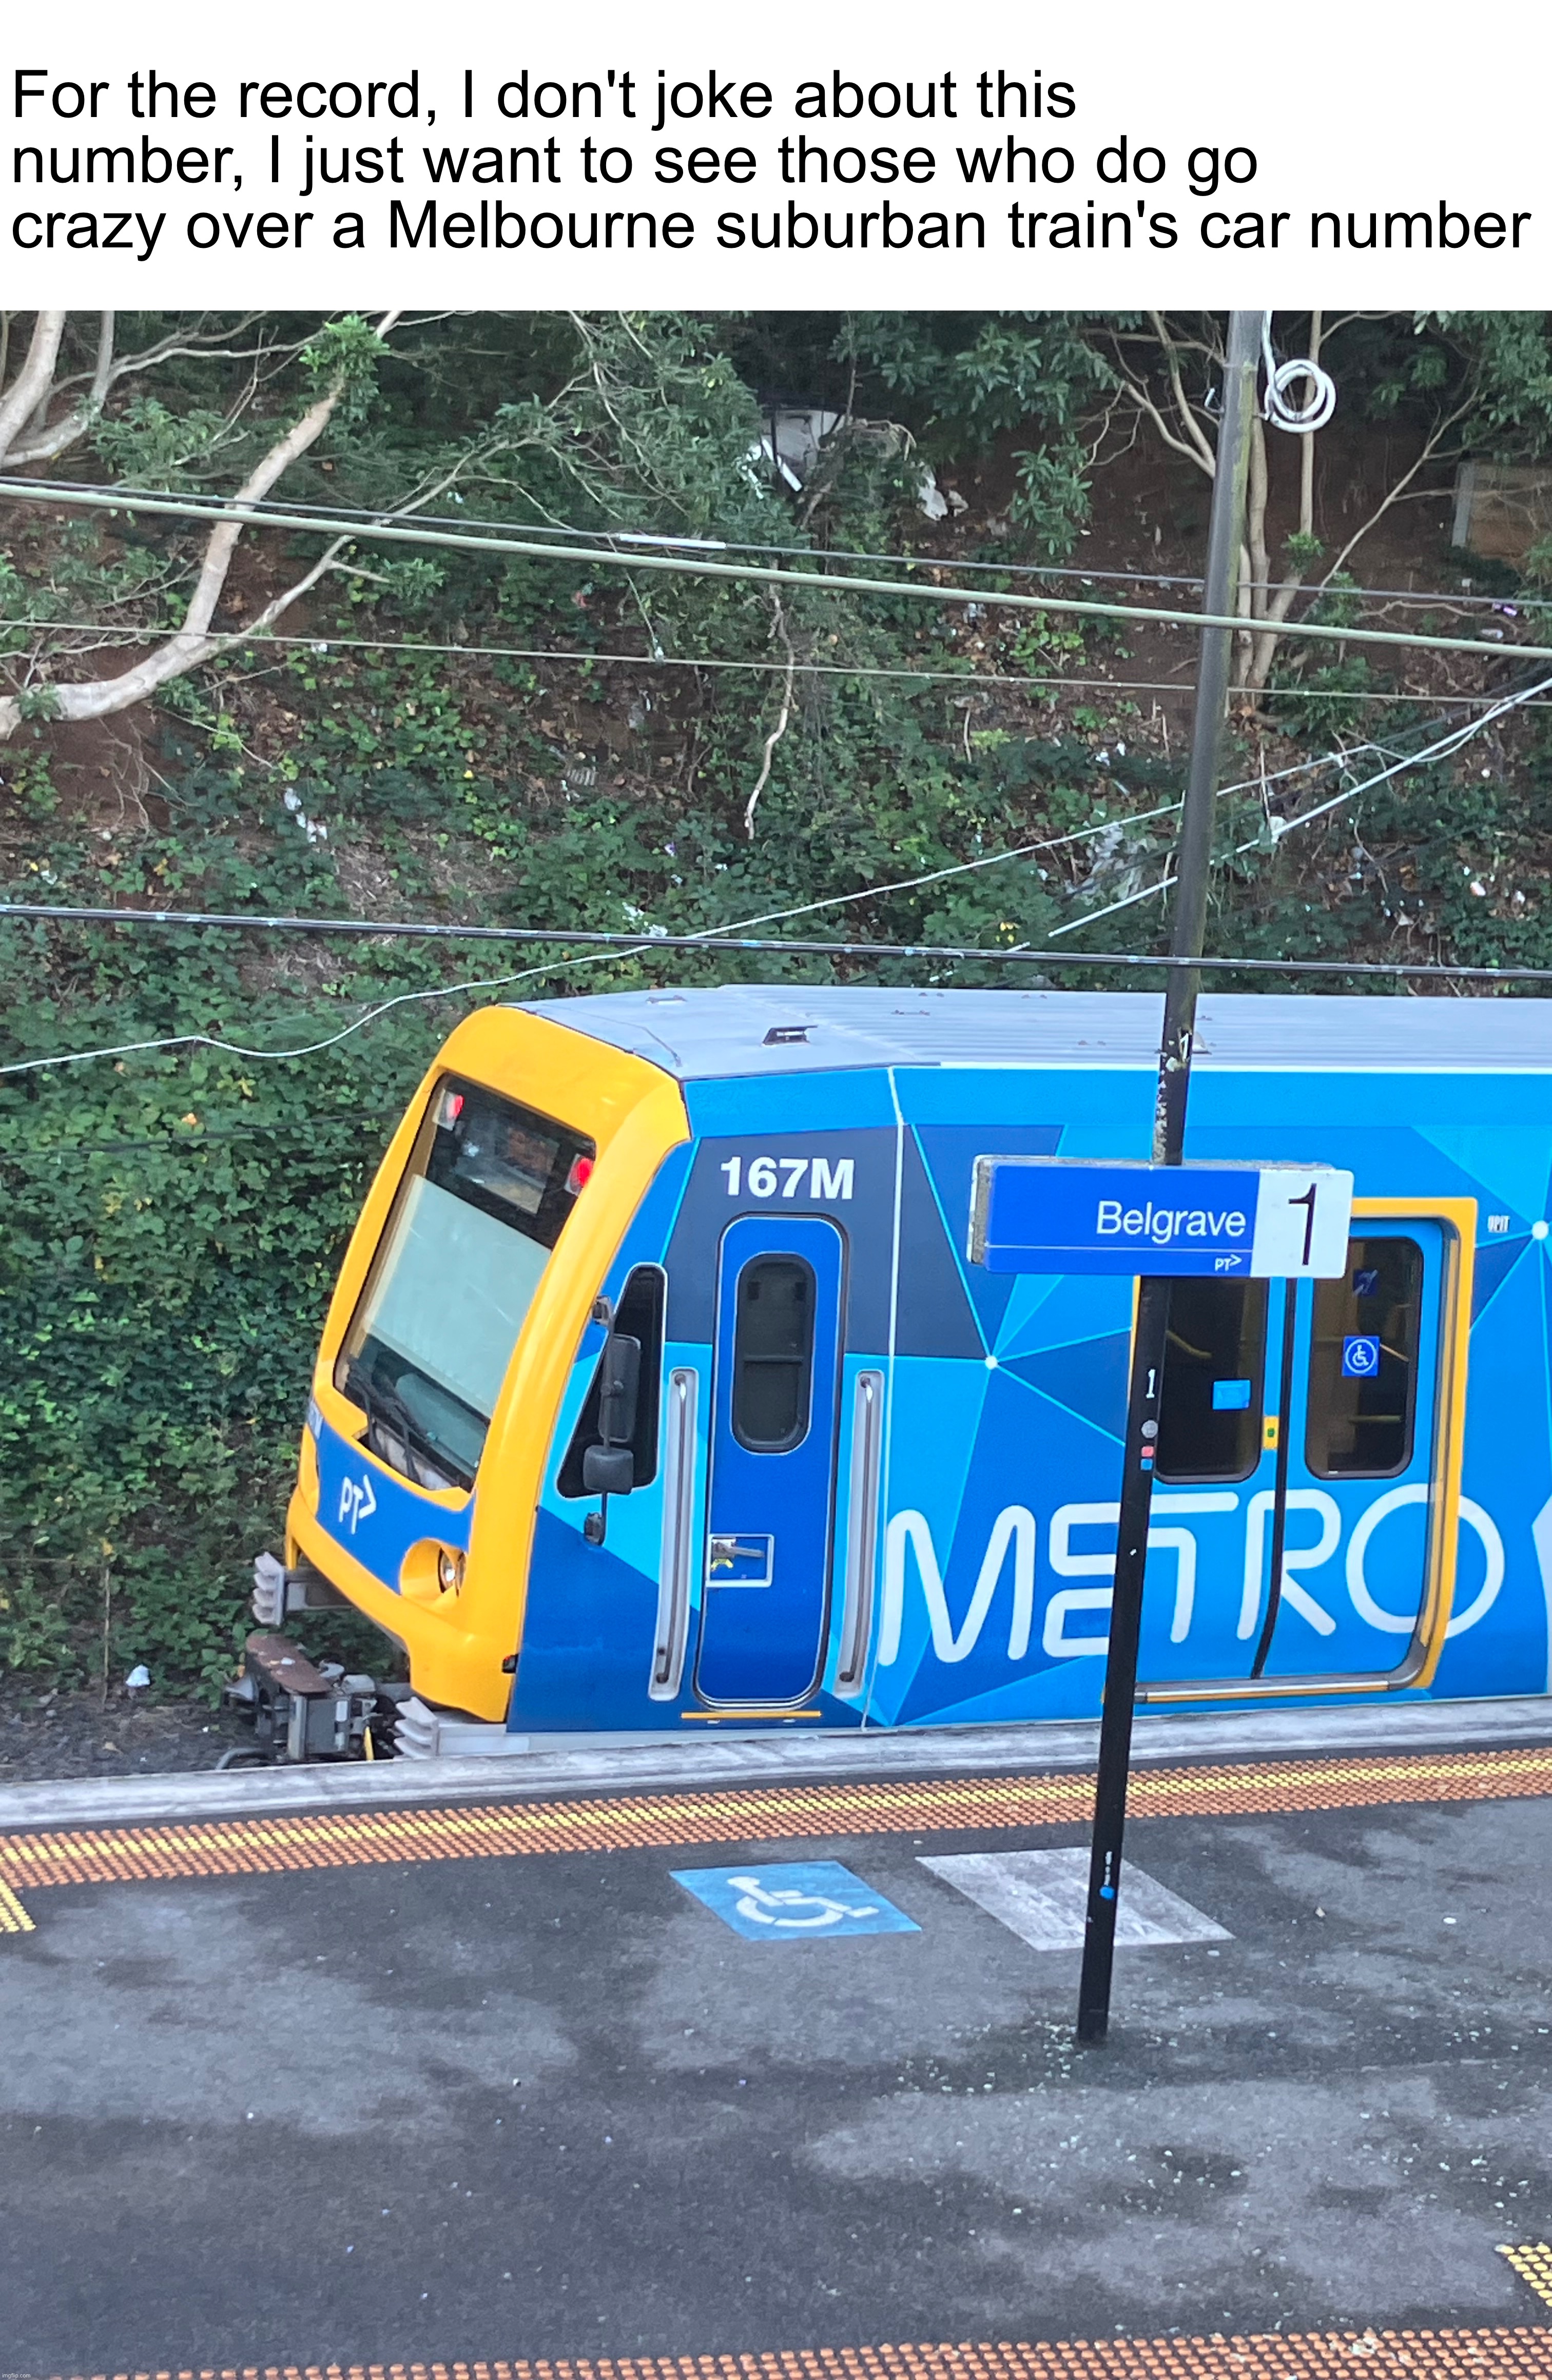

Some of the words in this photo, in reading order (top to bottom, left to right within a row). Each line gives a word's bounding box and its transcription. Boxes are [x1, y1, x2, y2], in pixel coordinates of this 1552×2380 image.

[720, 1156, 855, 1200] 167M
[1096, 1200, 1246, 1244] Belgrave
[1288, 1183, 1317, 1266] 1
[1145, 1369, 1156, 1399] 1
[878, 1482, 1505, 1666] METRO
